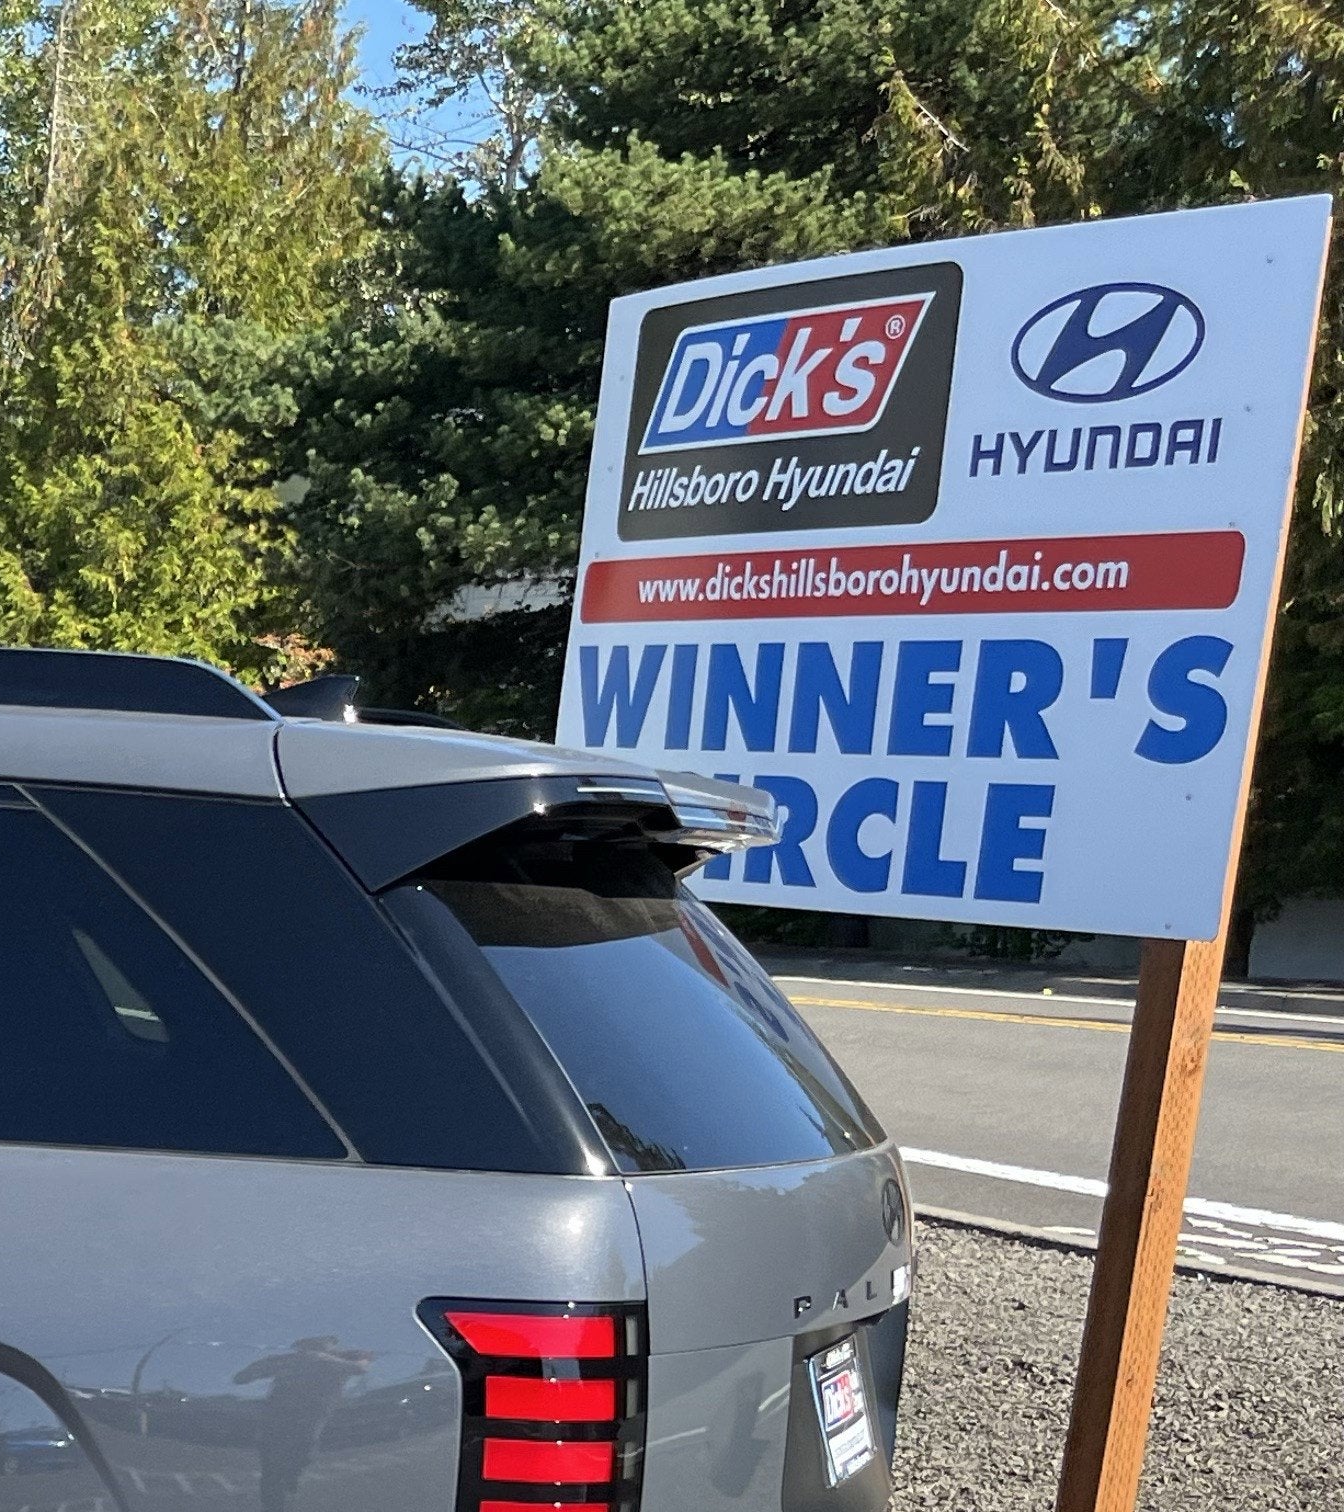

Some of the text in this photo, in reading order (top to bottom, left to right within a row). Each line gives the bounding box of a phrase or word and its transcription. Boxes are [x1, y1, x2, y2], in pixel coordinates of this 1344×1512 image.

[658, 317, 886, 434] Dick's
[628, 446, 921, 511] Hillsboro Hyundai
[969, 418, 1221, 478] HYUNDAI
[637, 551, 1129, 606] www.dickshillsborohyundai.com
[580, 635, 1235, 764] WINNER'S
[703, 773, 1056, 904] RCLE
